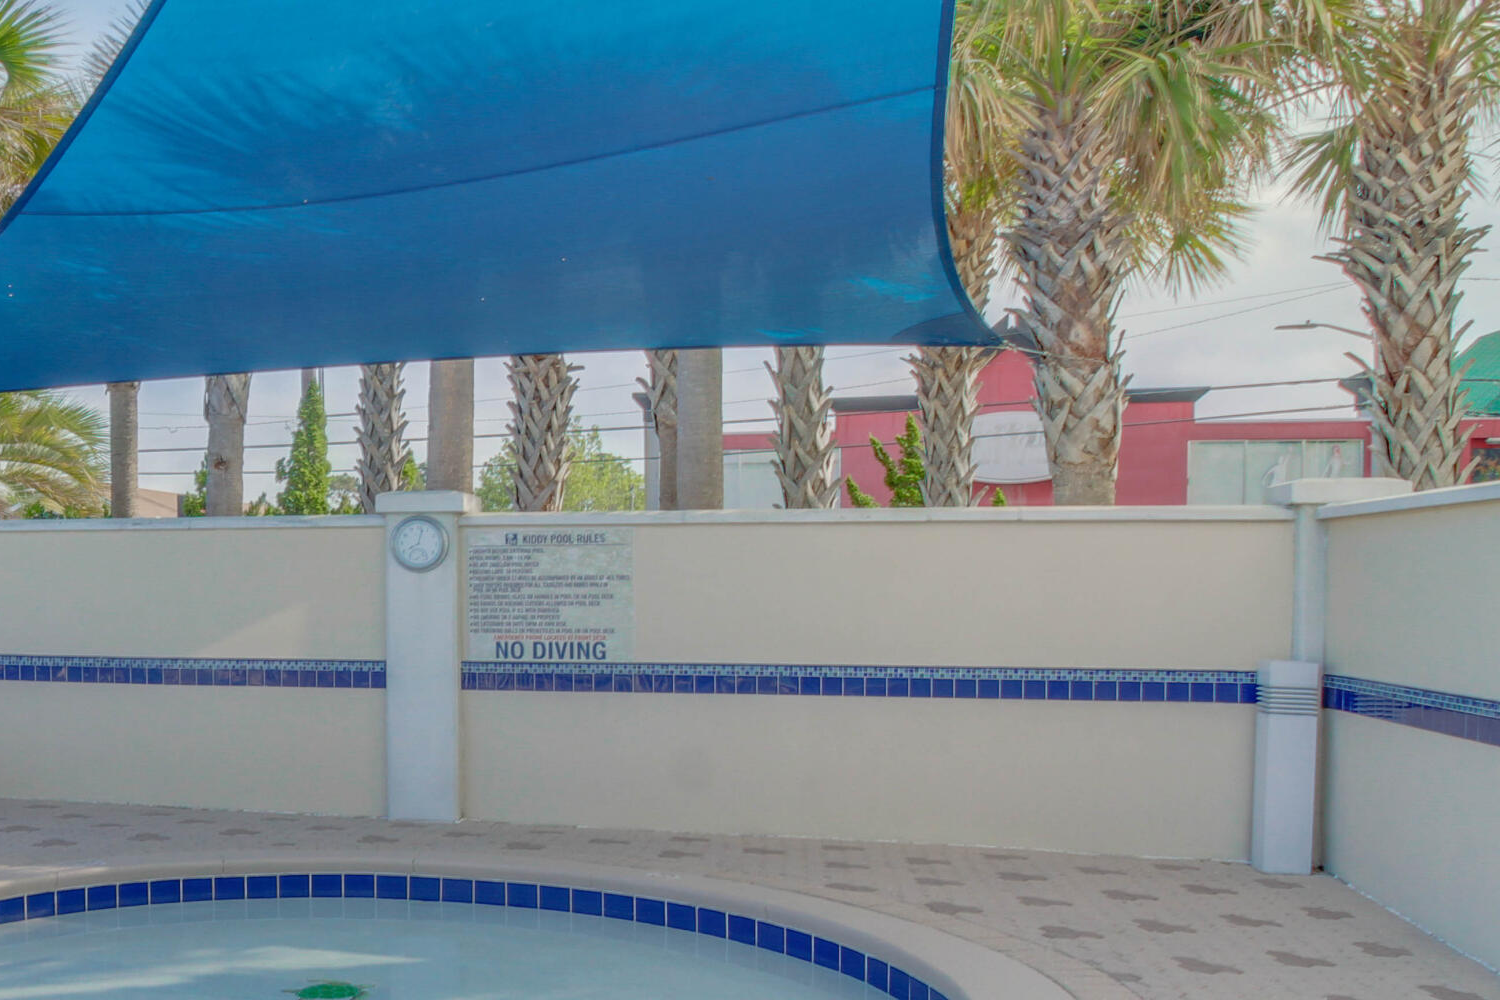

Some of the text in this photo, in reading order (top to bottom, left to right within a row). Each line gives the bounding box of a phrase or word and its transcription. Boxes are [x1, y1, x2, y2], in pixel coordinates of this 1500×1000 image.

[522, 533, 606, 544] KIDDY POOL RULES
[495, 641, 606, 660] NO DIVING
